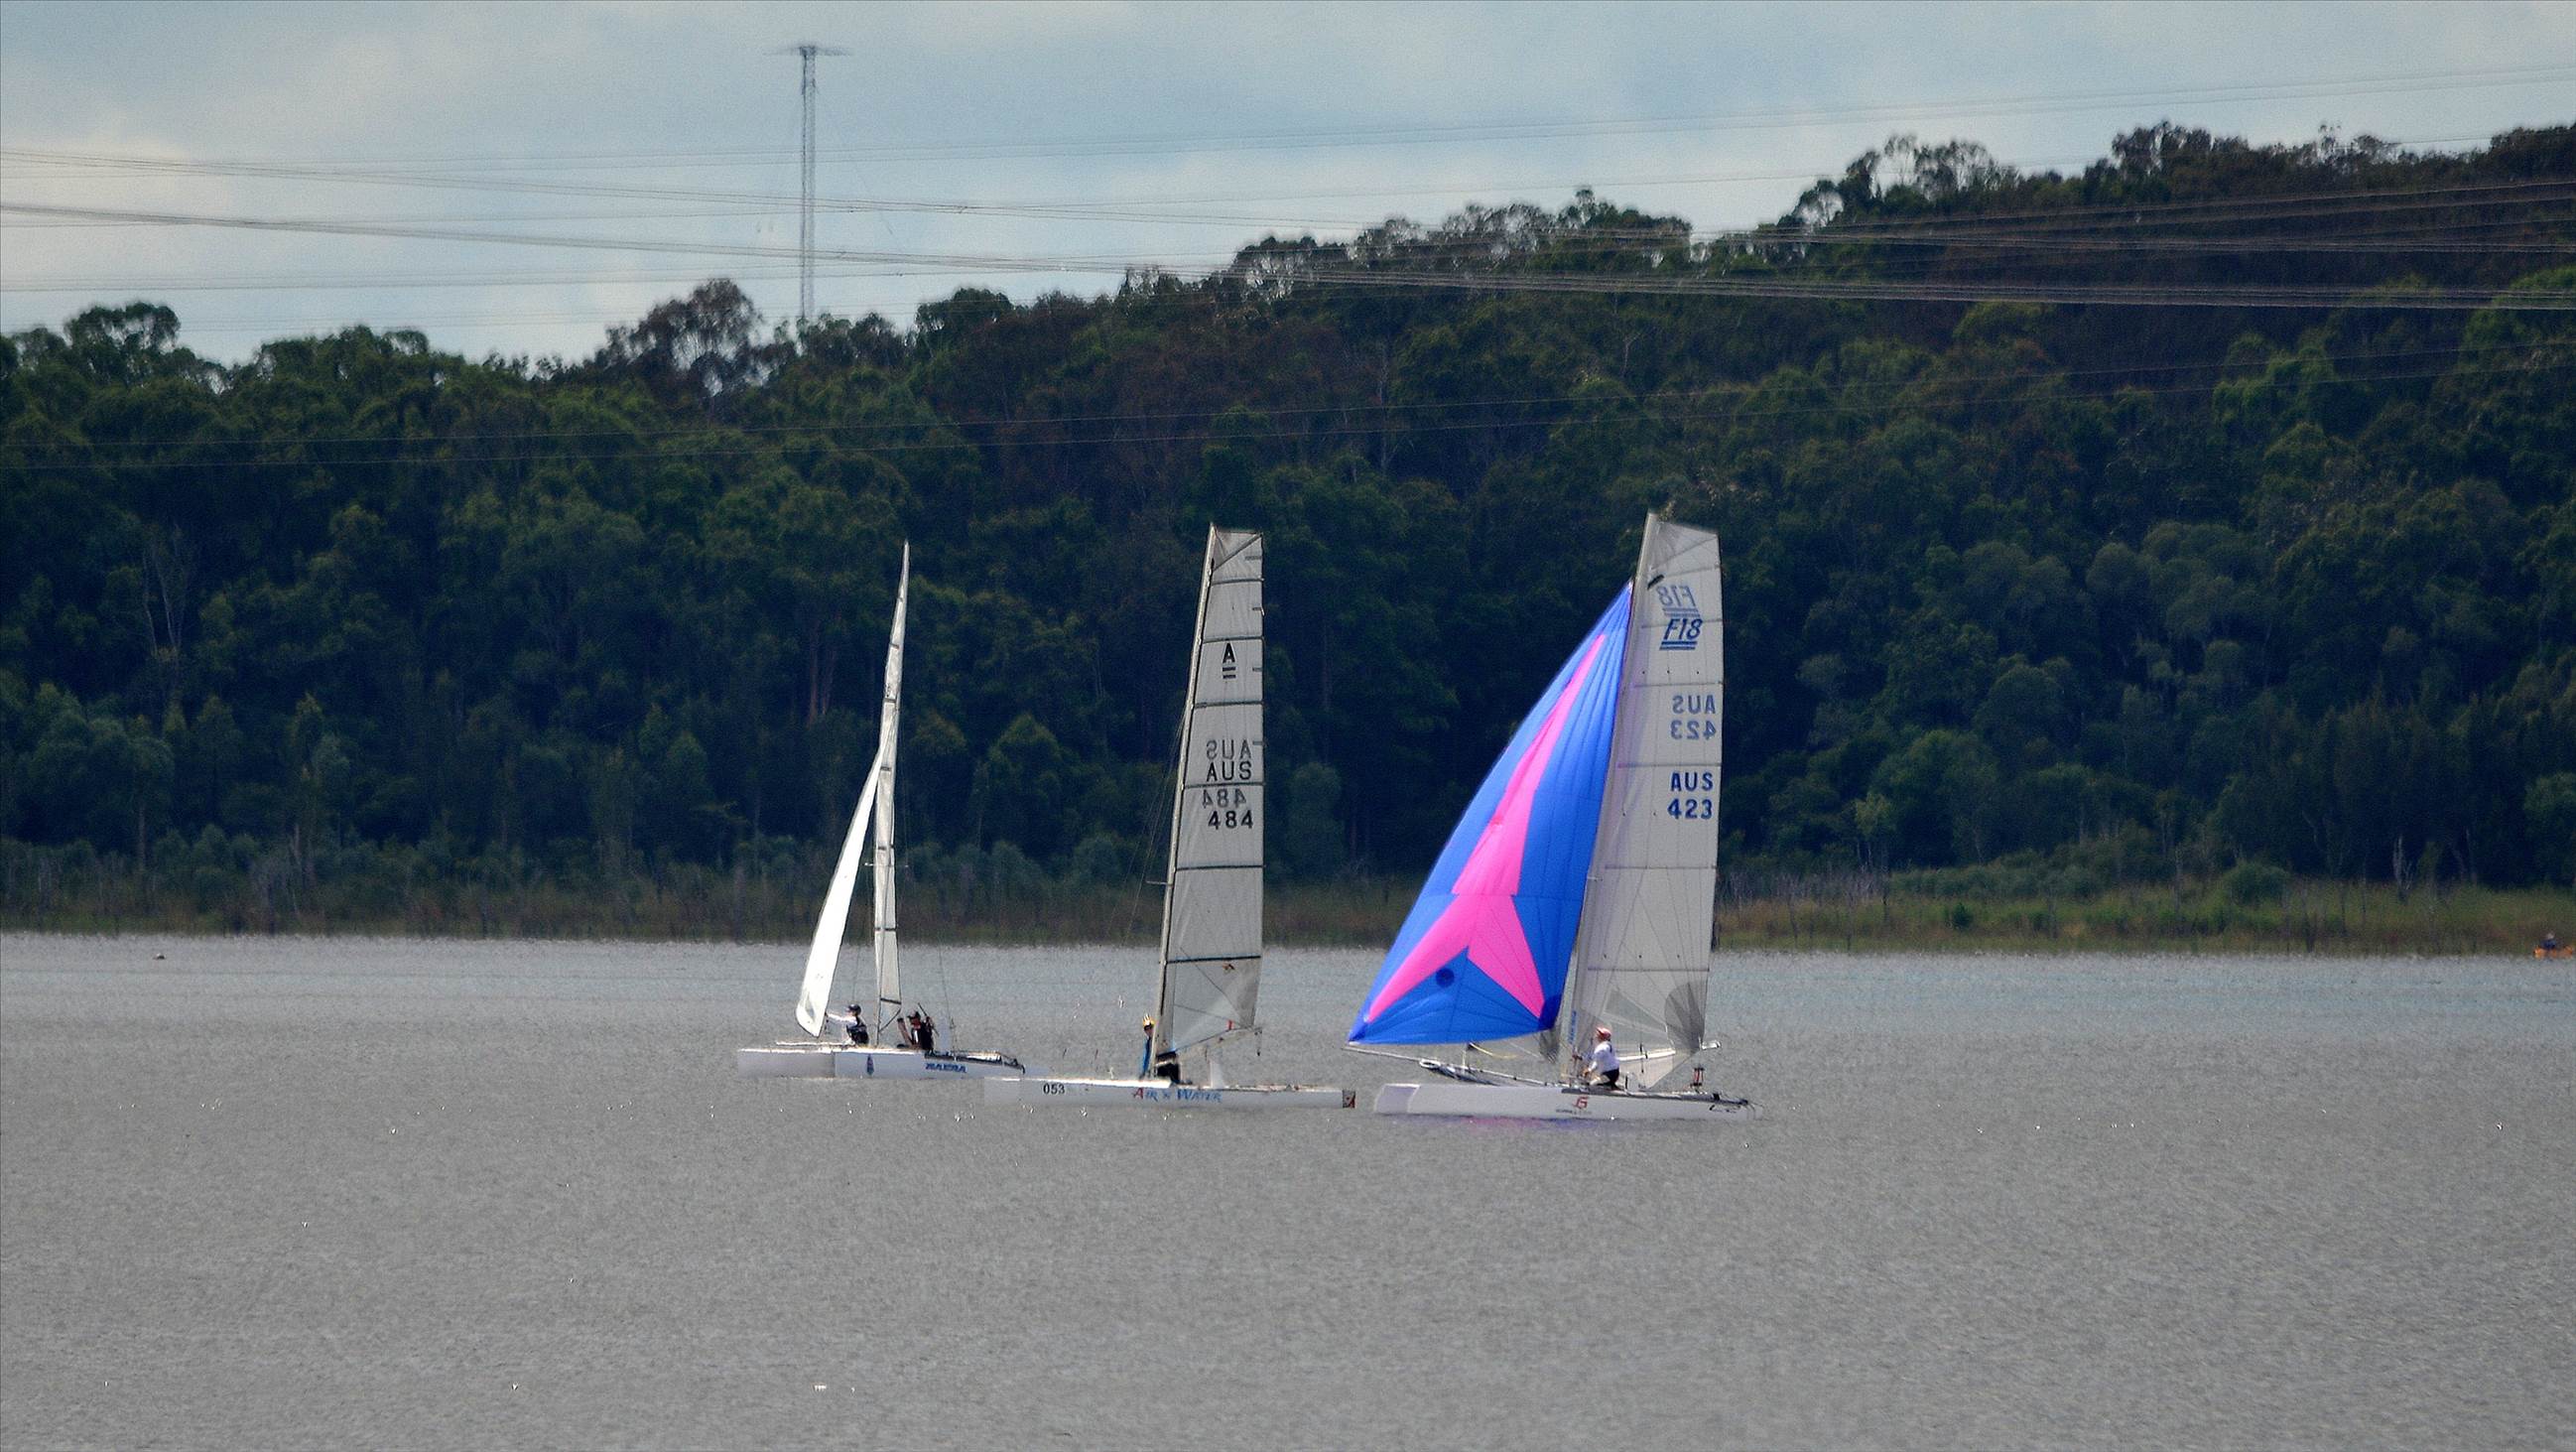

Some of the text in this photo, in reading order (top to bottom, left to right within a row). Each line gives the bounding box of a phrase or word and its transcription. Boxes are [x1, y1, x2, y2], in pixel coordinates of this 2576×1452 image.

[1663, 618, 1703, 641] F18
[1223, 643, 1235, 663] A
[1207, 761, 1252, 782] AUS
[1670, 771, 1714, 792] AUS
[1667, 798, 1714, 820] 423
[1209, 810, 1253, 831] 484
[1043, 1083, 1065, 1095] 053
